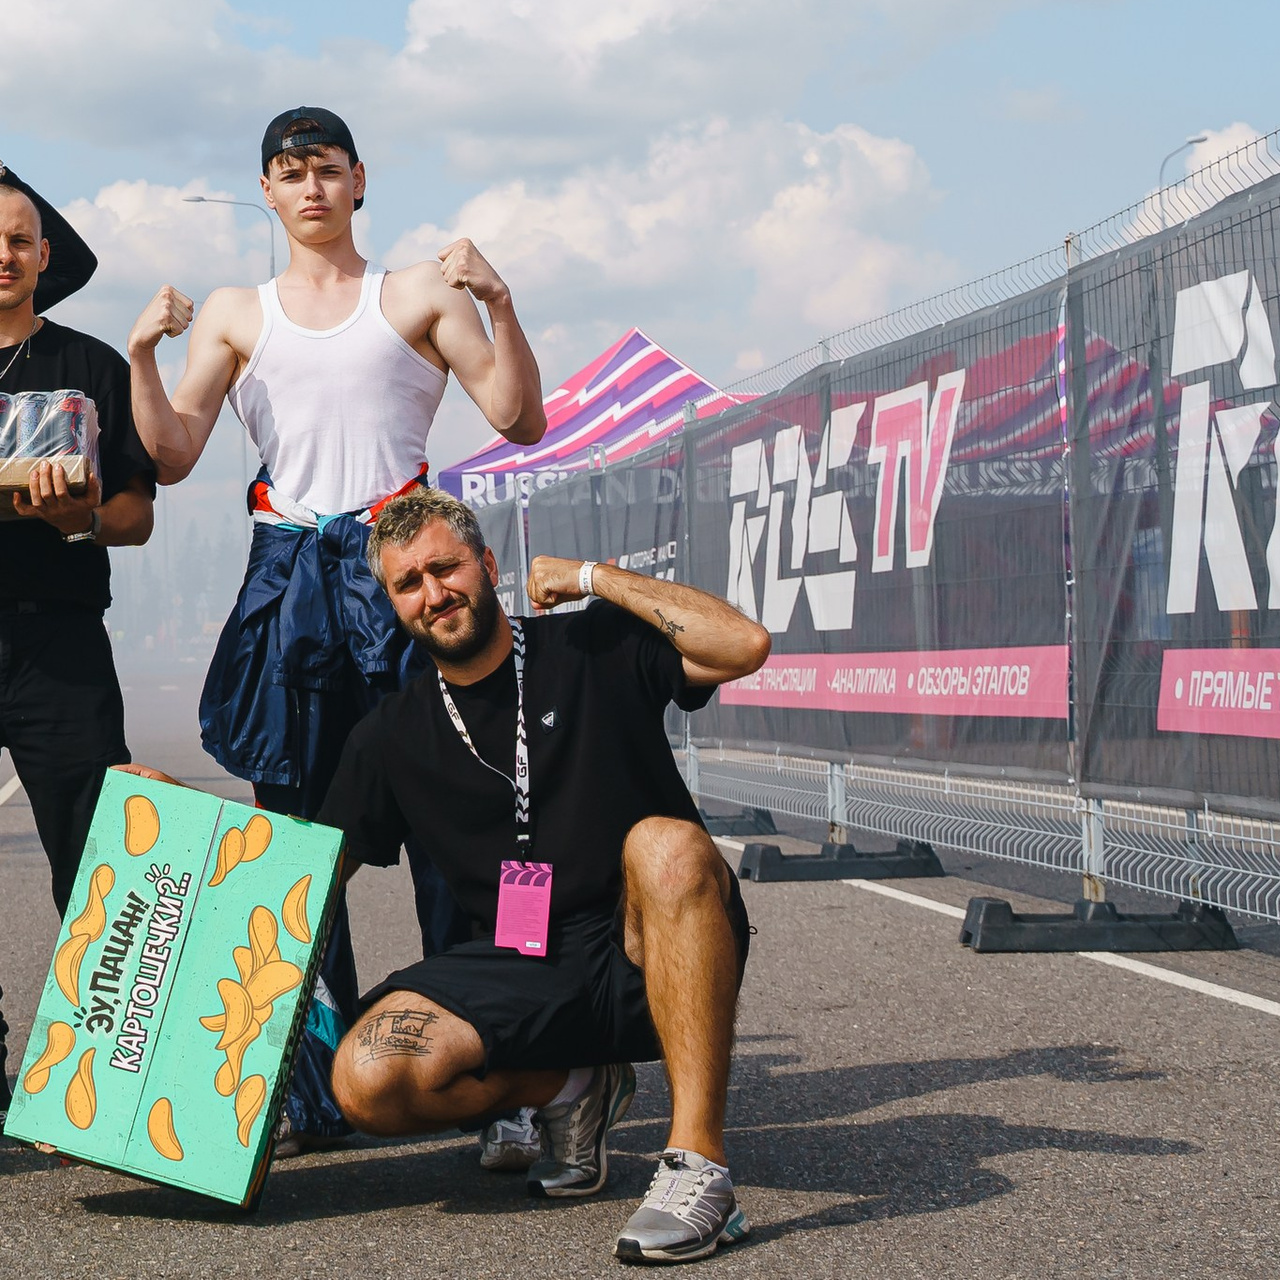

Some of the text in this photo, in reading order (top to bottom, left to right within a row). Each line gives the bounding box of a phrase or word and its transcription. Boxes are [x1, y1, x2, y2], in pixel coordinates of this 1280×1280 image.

[831, 668, 896, 694] АНАЛИТИКА
[917, 667, 971, 696] ОБЗОРЫ
[972, 665, 1031, 696] ЭТАПОВ
[1188, 670, 1275, 710] ПРЯМЫЕ
[516, 754, 528, 778] GF
[89, 890, 151, 994] ПАЦАН!
